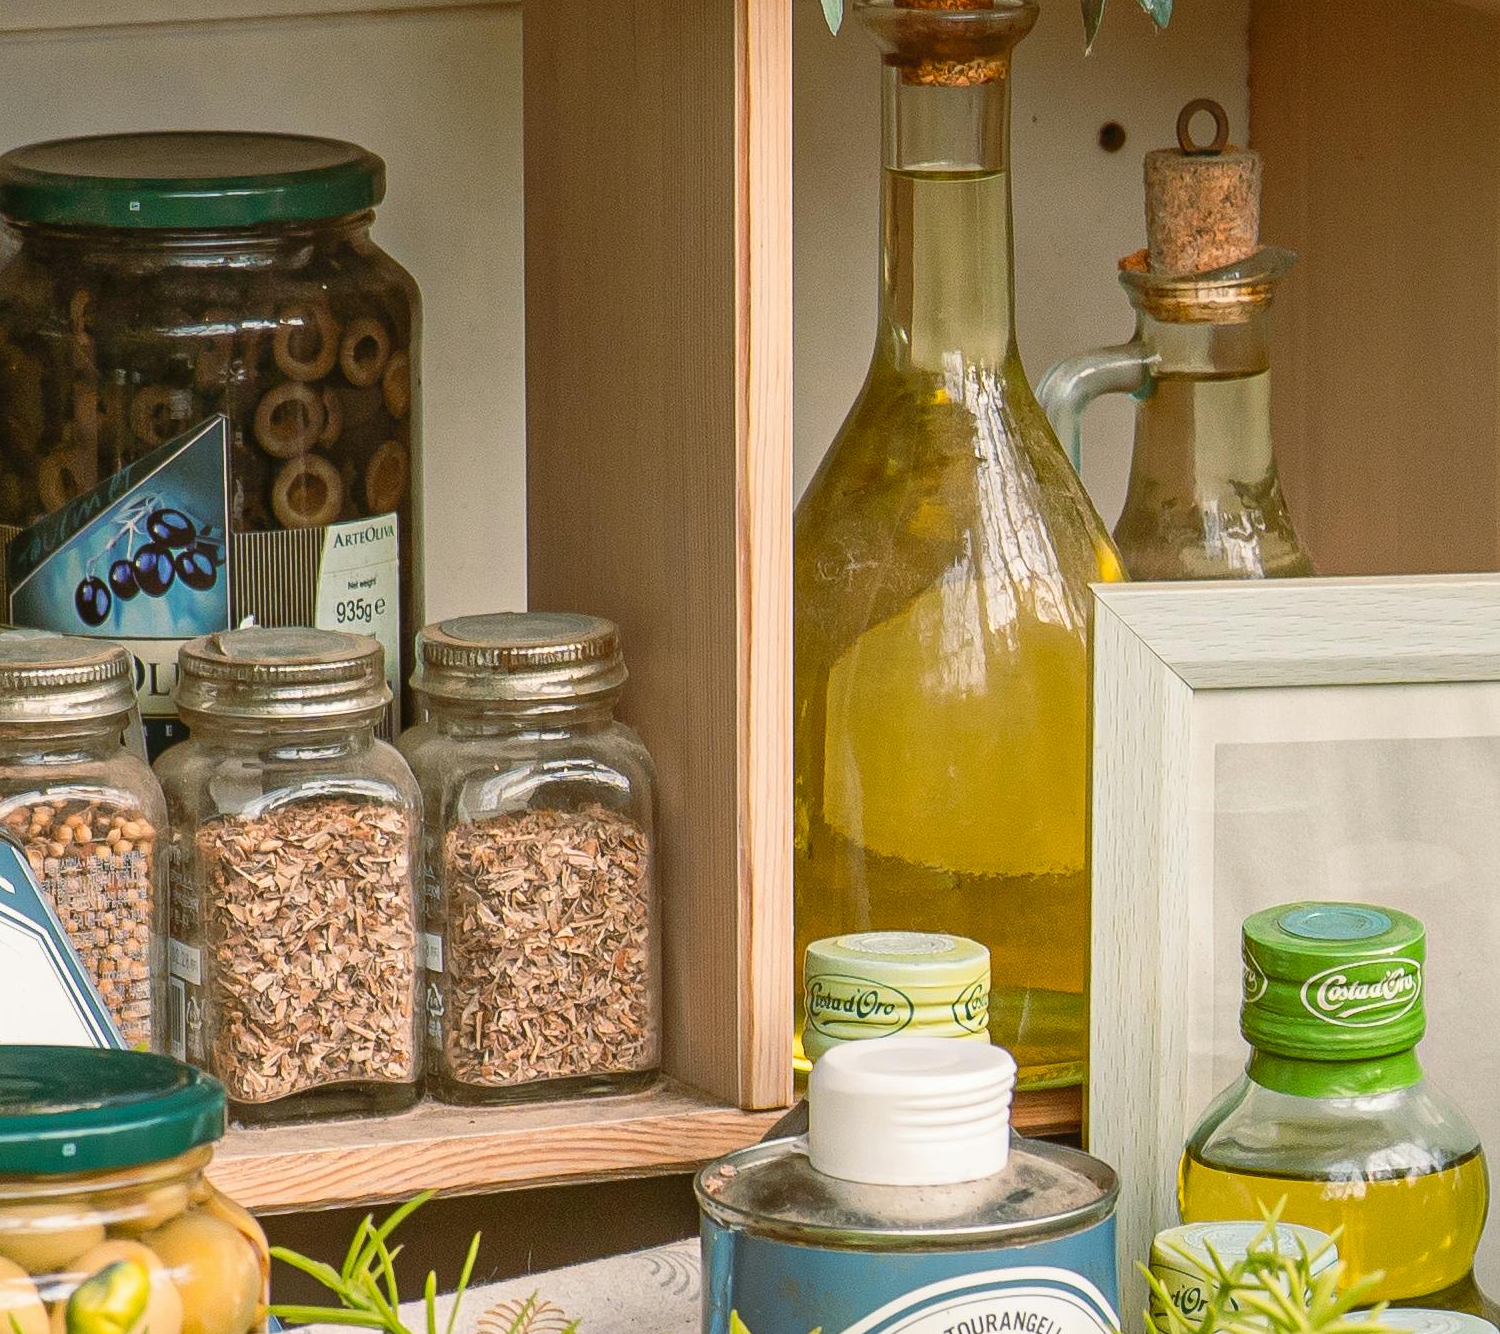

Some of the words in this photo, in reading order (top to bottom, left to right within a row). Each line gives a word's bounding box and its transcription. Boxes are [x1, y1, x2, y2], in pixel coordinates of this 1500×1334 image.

[336, 598, 372, 624] 935g
[810, 982, 841, 1016] Costa
[843, 988, 896, 1018] d'Oro
[1317, 975, 1369, 1012] Costa
[1171, 1283, 1210, 1315] d'Or
